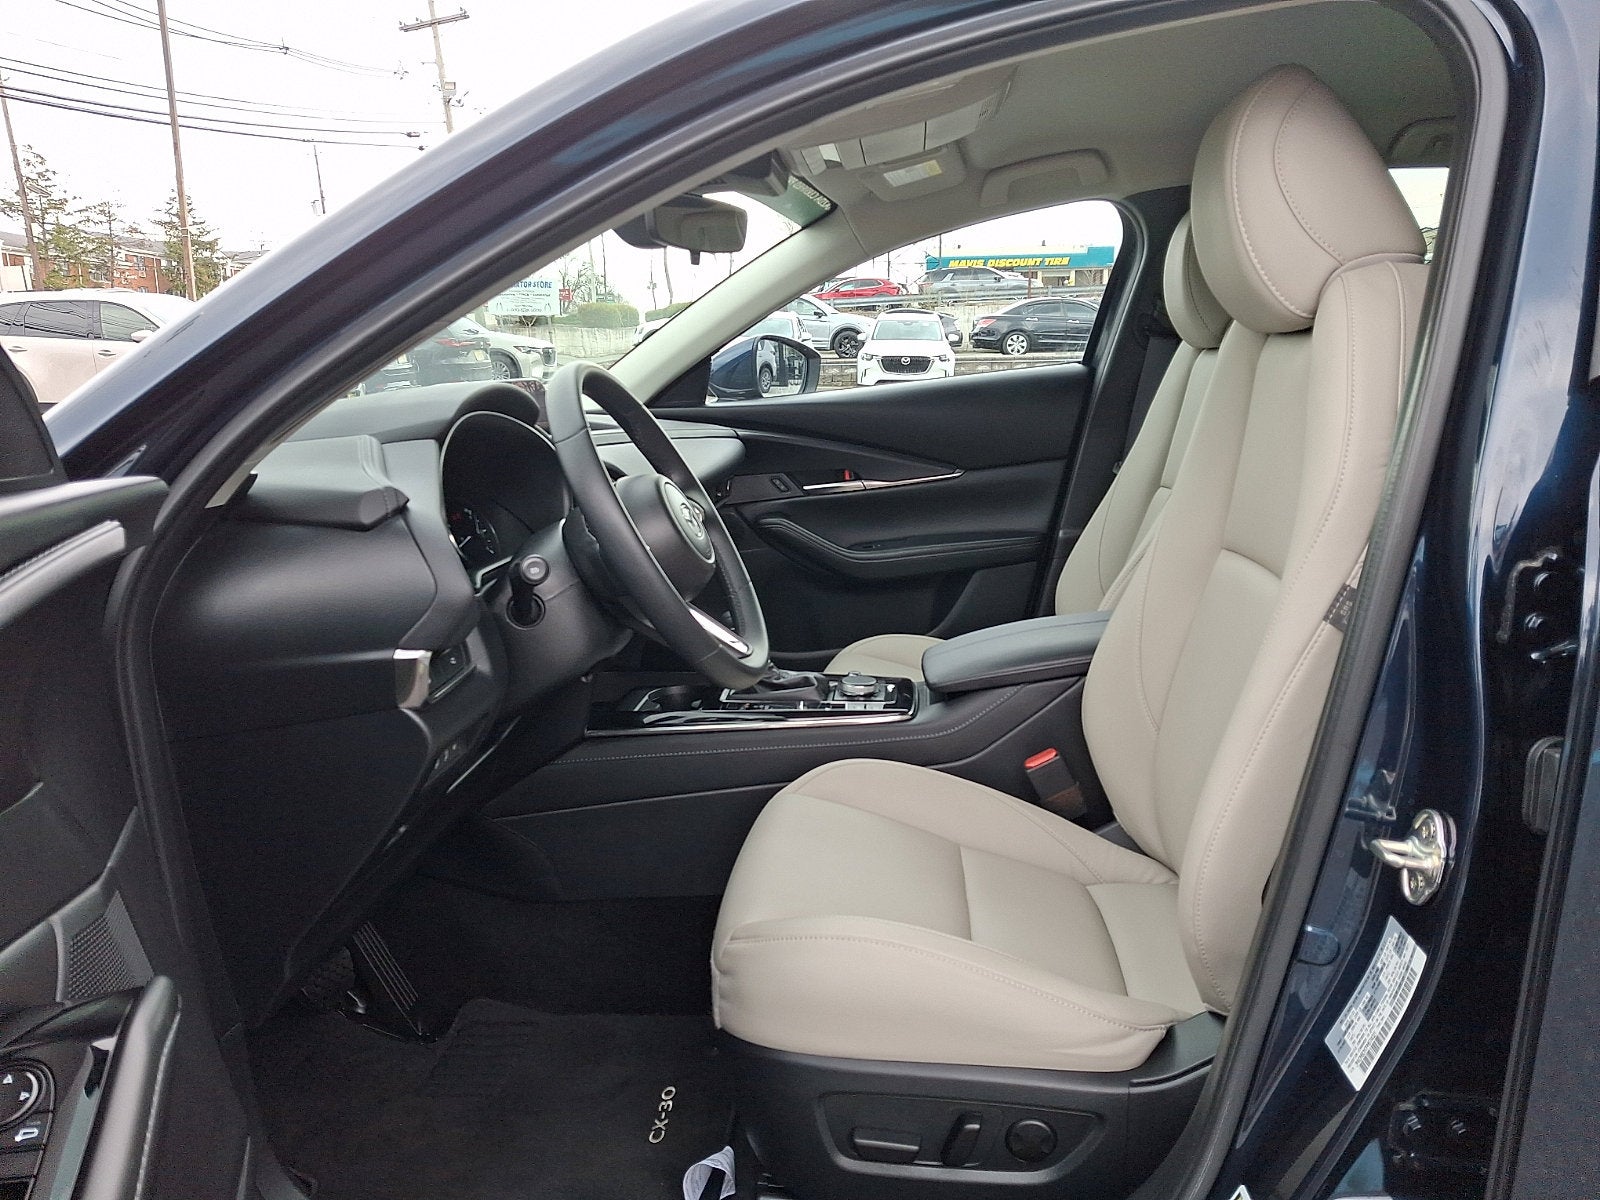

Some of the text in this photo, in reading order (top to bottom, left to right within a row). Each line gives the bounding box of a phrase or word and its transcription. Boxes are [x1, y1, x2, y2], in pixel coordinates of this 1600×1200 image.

[949, 256, 1070, 268] MAVIS DISCOUNT TIRE
[648, 1085, 676, 1144] CX-30
